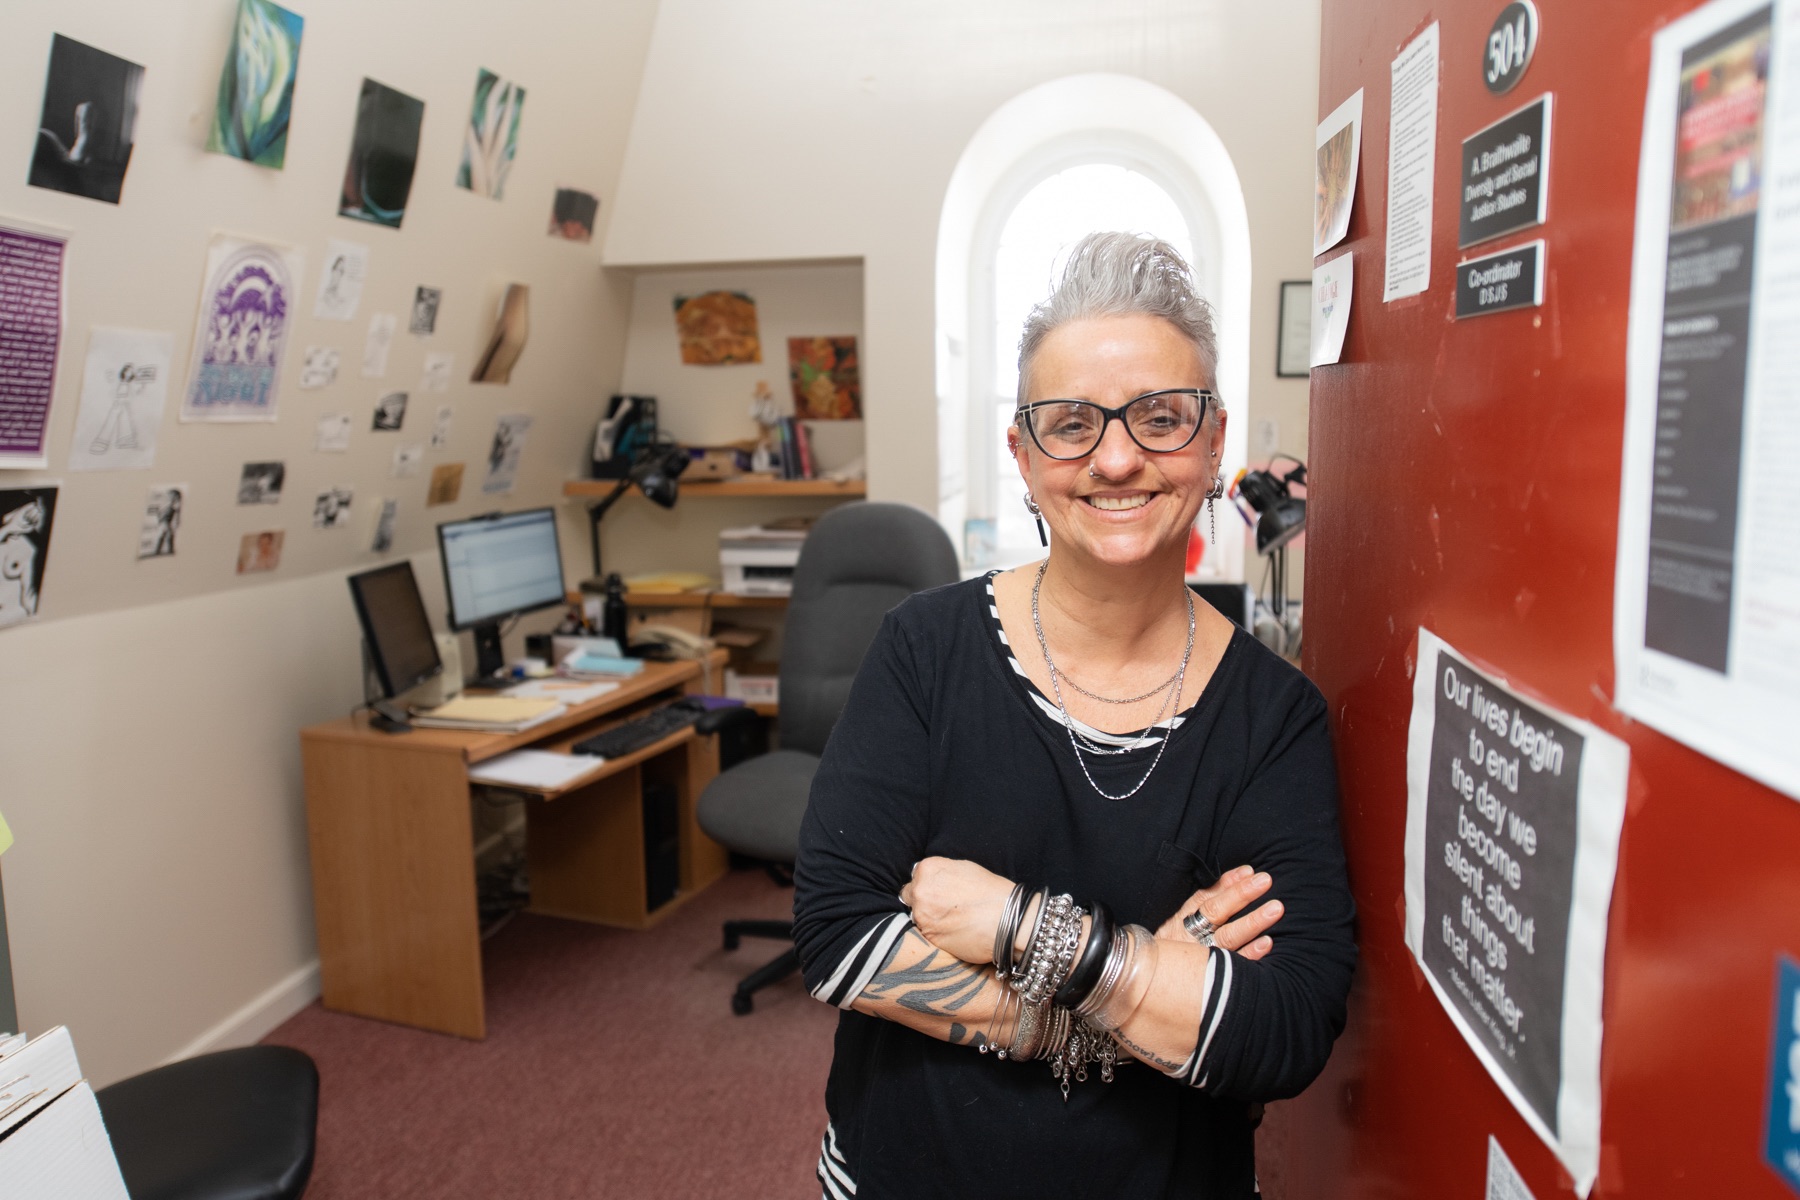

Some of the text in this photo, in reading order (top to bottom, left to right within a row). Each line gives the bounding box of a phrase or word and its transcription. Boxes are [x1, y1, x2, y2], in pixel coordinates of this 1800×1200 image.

[1487, 11, 1526, 83] 504
[1464, 154, 1538, 202] Diversity and Social
[1470, 133, 1532, 177] A. Braithwaite
[1470, 187, 1527, 222] Justice Studies
[1468, 260, 1523, 289] Co-ordinator
[1444, 666, 1564, 776] Our lives begin
[1469, 727, 1520, 793] to end
[1452, 757, 1537, 856] the day we
[1458, 804, 1522, 890] become
[1444, 841, 1536, 954] silent about
[1461, 895, 1508, 971] things
[1442, 914, 1526, 1043] that matter.
[1469, 991, 1490, 1026] Luther
